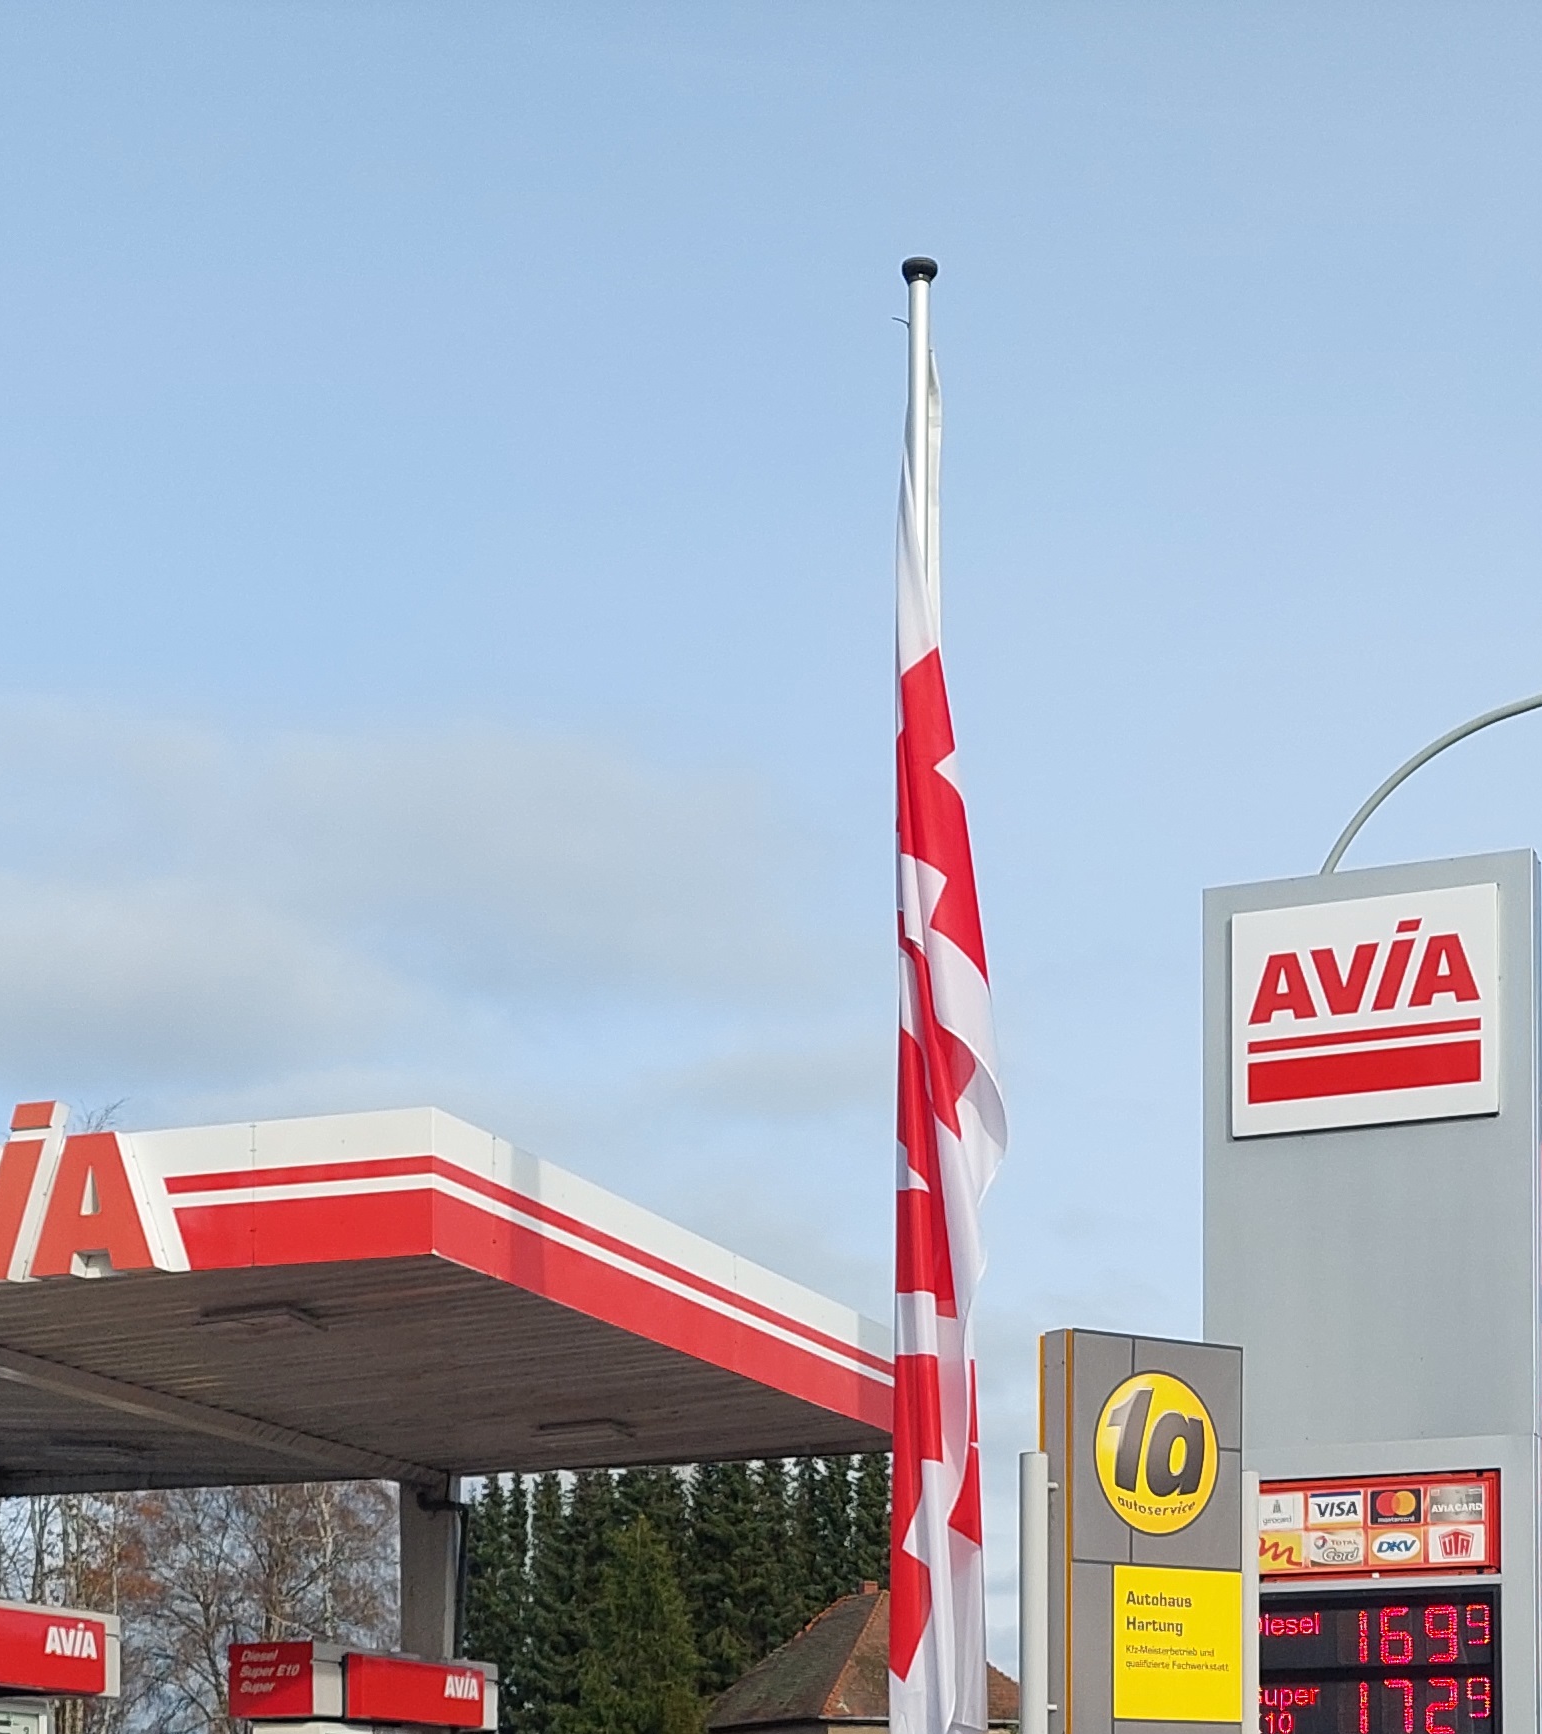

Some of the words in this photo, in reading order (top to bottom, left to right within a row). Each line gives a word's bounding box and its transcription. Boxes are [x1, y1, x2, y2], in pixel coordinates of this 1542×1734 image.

[1106, 1387, 1205, 1498] 1a
[1116, 1494, 1197, 1516] autoservice
[1315, 1501, 1359, 1518] VISA
[1262, 1515, 1293, 1526] girocard
[1330, 1539, 1358, 1547] TOTAL
[1376, 1539, 1417, 1554] DKV
[1125, 1590, 1193, 1608] Autohaus
[1125, 1615, 1184, 1637] Hartung
[1258, 1611, 1321, 1637] iesel
[44, 1621, 98, 1660] AVIA
[240, 1649, 279, 1663] Diesel
[1199, 1647, 1215, 1658] und
[240, 1664, 276, 1679] Super
[276, 1663, 301, 1677] E10
[240, 1680, 276, 1695] Super
[444, 1670, 479, 1701] AVIA
[1259, 1711, 1294, 1734] 10
